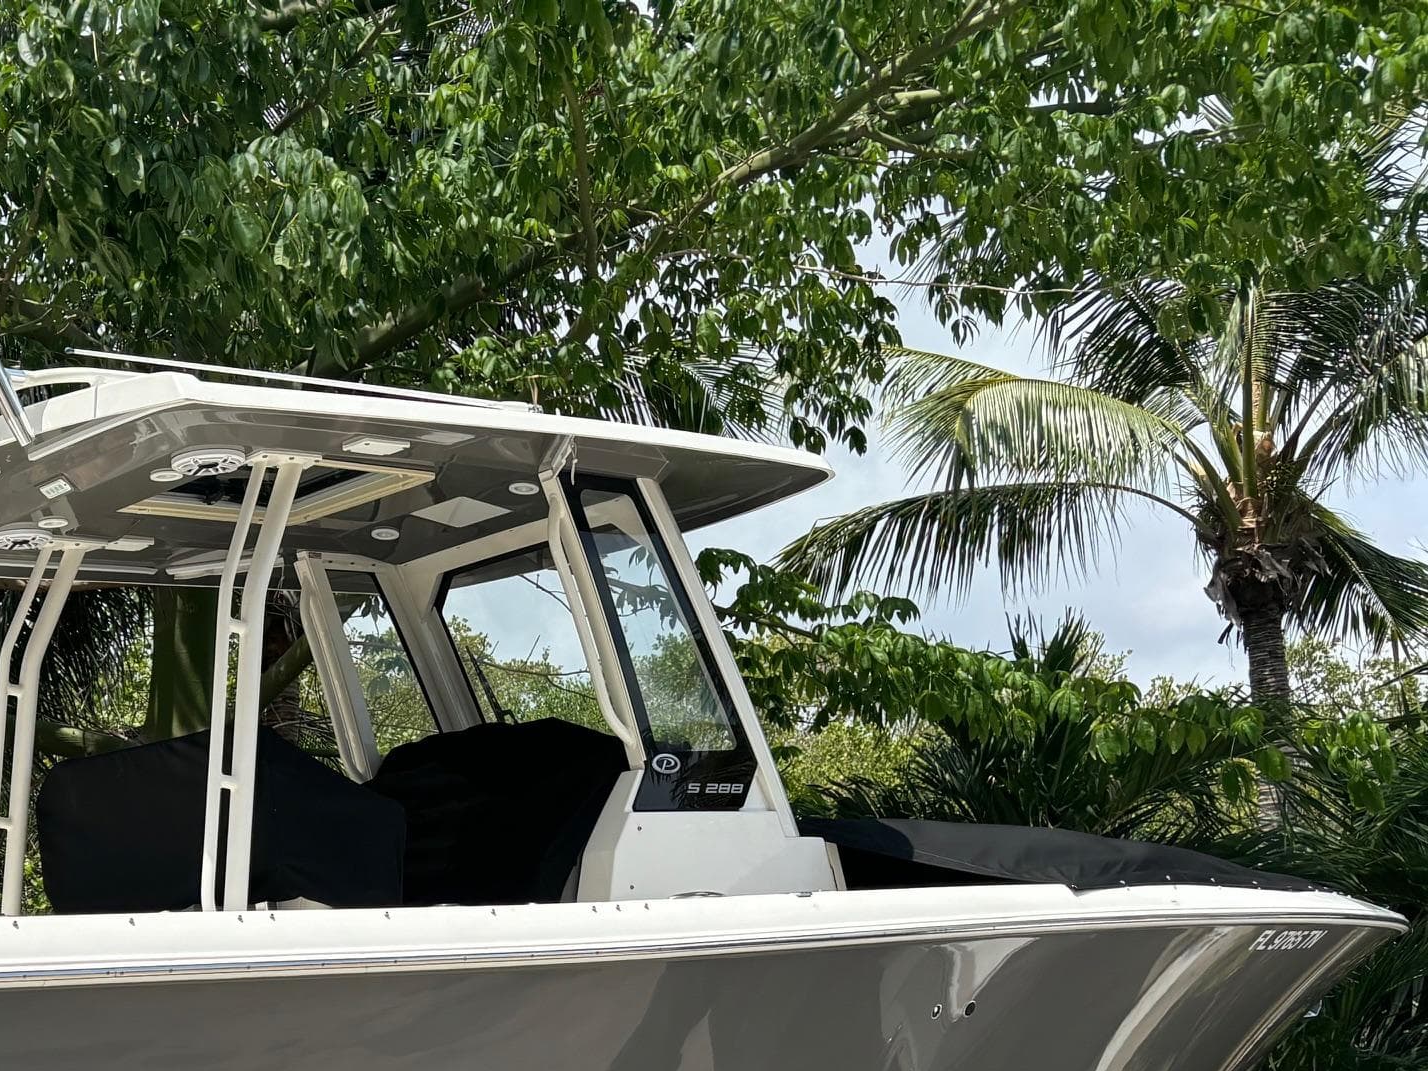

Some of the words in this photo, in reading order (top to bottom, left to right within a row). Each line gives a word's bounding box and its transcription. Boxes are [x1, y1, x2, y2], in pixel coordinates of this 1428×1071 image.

[687, 783, 701, 794] S
[705, 783, 744, 794] 288
[1249, 930, 1276, 951] FL
